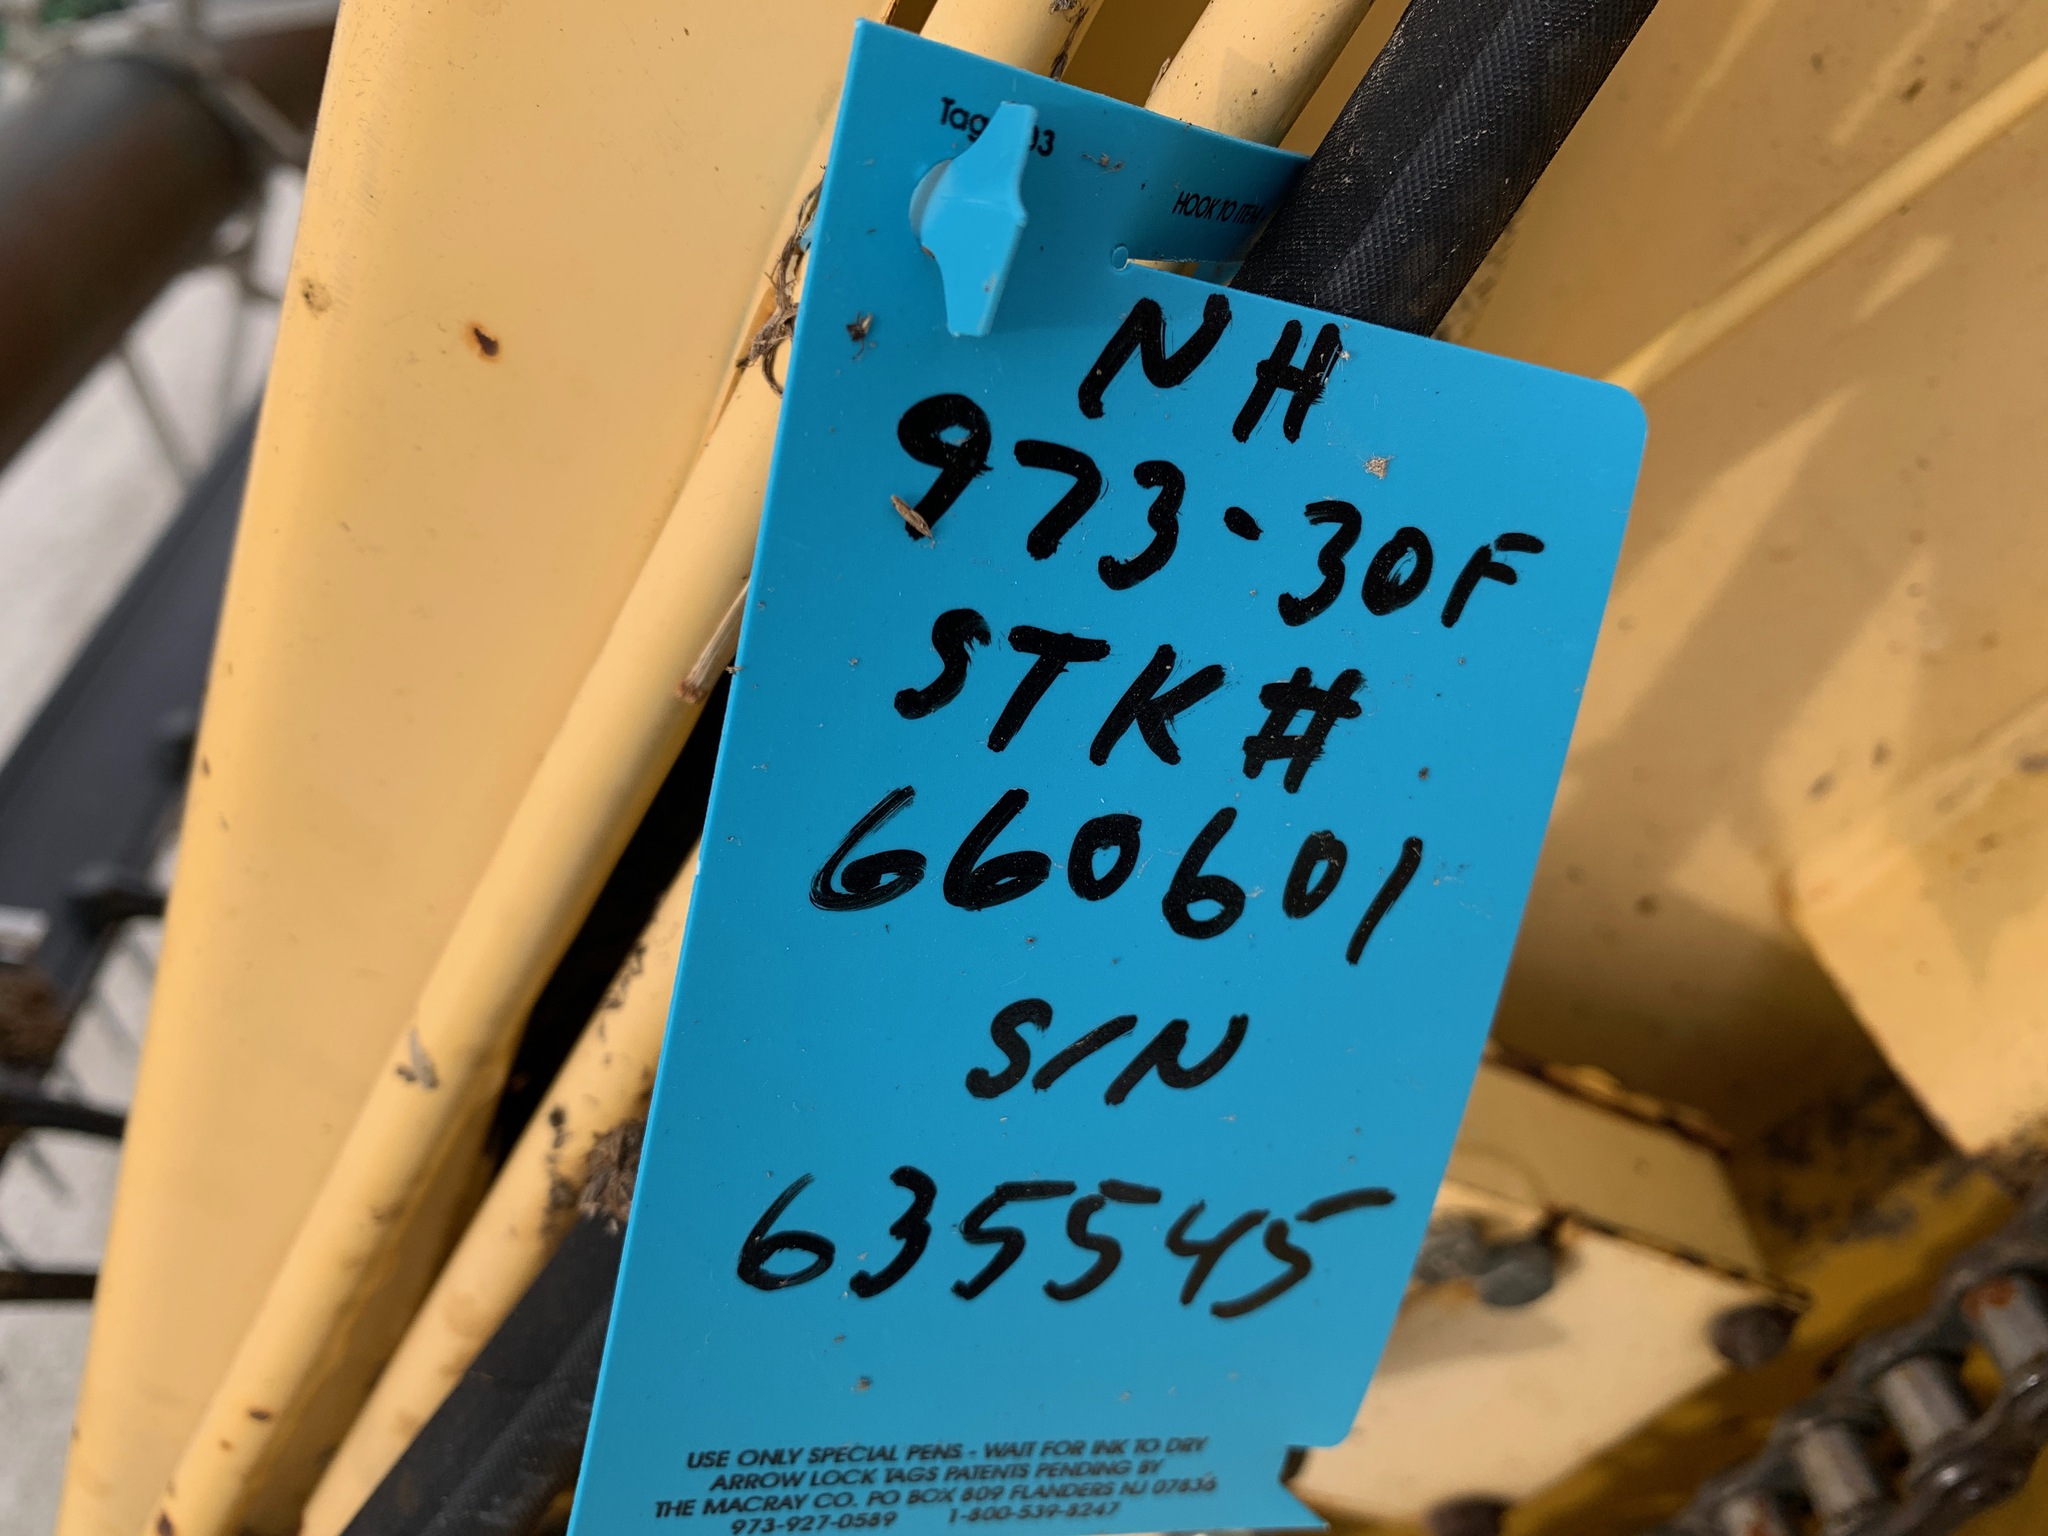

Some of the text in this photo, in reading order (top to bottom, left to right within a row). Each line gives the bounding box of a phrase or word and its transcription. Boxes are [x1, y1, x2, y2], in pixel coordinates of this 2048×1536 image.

[941, 96, 991, 143] Tag
[1172, 190, 1265, 226] HOOK TO ITEM
[809, 786, 1424, 966] 660601
[965, 998, 1249, 1106] S/N
[736, 1165, 1396, 1319] 635545
[687, 1450, 731, 1469] USE
[736, 1448, 804, 1467] ONLY
[806, 1444, 899, 1465] SPECIAL
[904, 1442, 962, 1461] PENS
[984, 1440, 1037, 1459] WAIT
[1040, 1439, 1087, 1457] FOR
[1090, 1437, 1130, 1456] INK
[1133, 1437, 1161, 1455] TO
[1164, 1435, 1210, 1454] DRY
[709, 1458, 1165, 1492] ARROW LOCK TAGS PATENTS PENDING BY
[655, 1498, 697, 1518] THE
[702, 1494, 811, 1516] MACRAY
[812, 1492, 858, 1510] CO.
[866, 1490, 902, 1508] PO
[906, 1487, 958, 1506] BOX
[1008, 1481, 1118, 1501] FLANDERS
[1119, 1480, 1149, 1496] NJ
[731, 1511, 900, 1536] 973-927-0589
